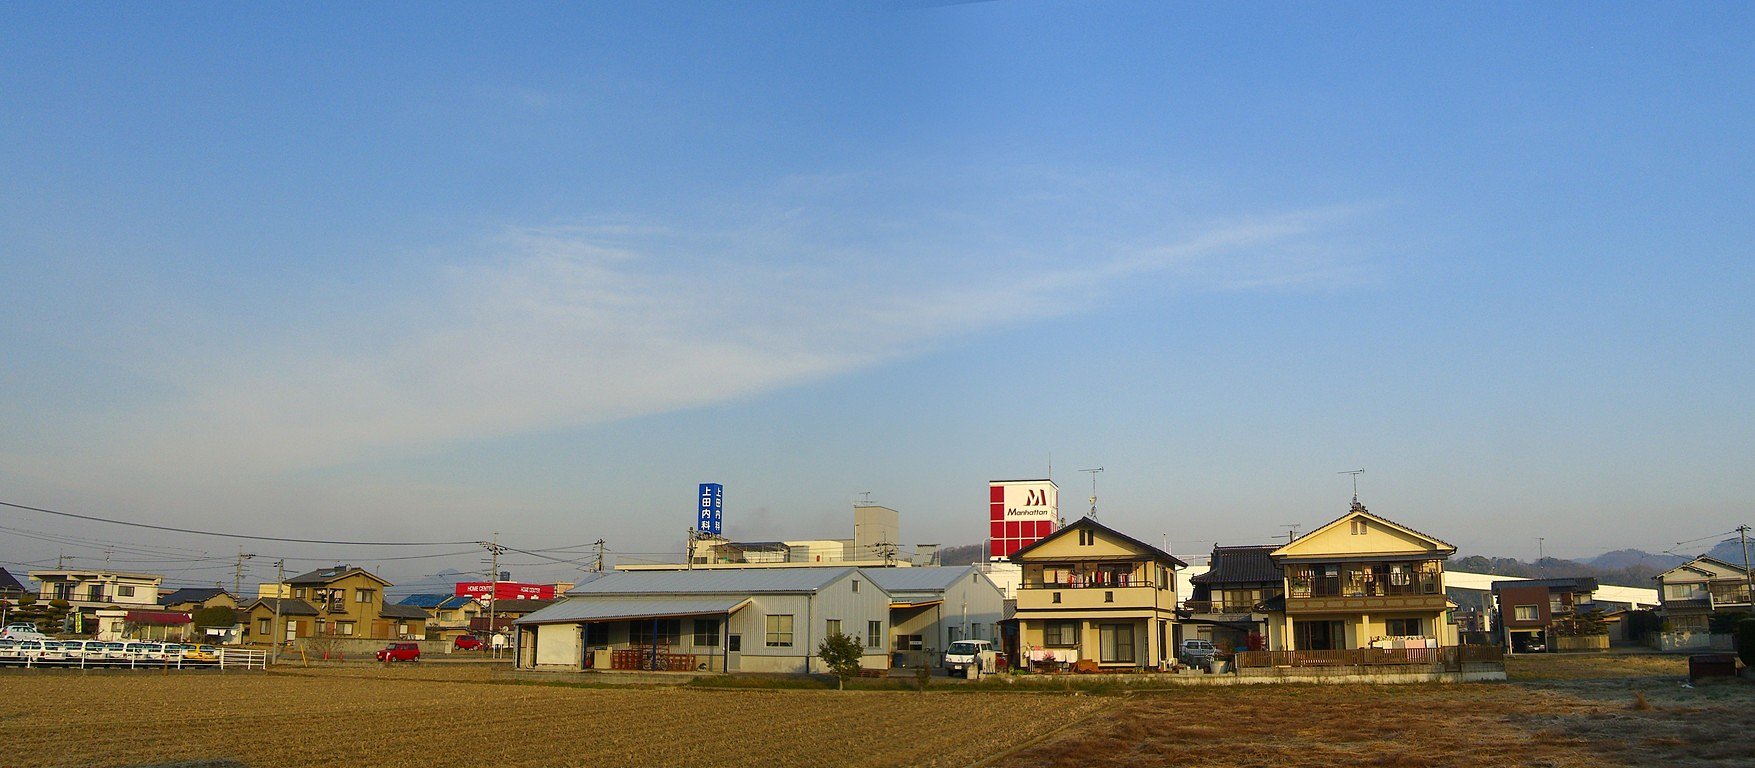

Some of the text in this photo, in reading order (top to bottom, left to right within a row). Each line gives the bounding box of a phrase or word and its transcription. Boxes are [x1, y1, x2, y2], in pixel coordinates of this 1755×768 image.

[701, 486, 712, 531] 上田内科
[1007, 508, 1048, 516] Manhattan
